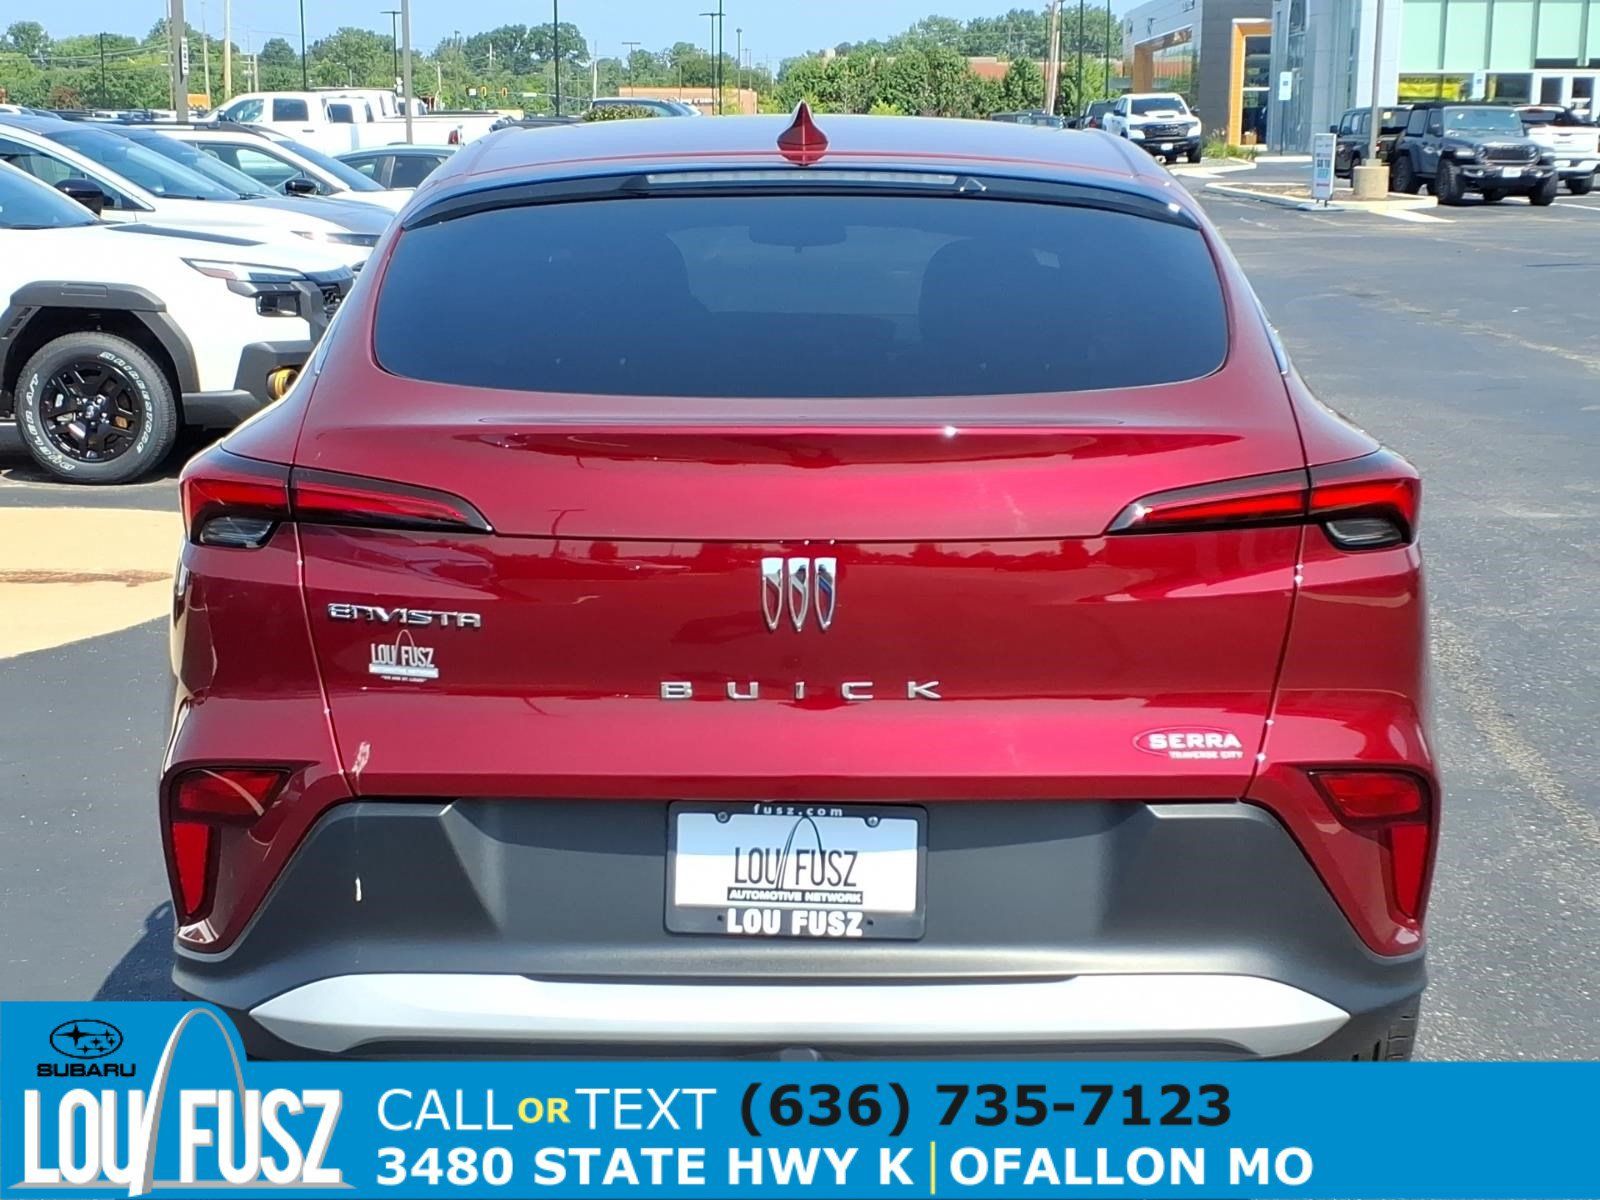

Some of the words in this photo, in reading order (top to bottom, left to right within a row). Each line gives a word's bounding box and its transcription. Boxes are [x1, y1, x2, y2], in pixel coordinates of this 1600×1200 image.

[327, 602, 481, 629] ENVISTA
[370, 643, 396, 665] LOU
[401, 645, 435, 667] FUSZ
[660, 681, 942, 701] BUICK
[1148, 733, 1242, 750] SERRA
[753, 804, 844, 818] fusz.com
[734, 847, 781, 884] LOU
[795, 848, 859, 887] FUSZ
[729, 889, 803, 902] AUTOMOTIVE
[805, 890, 863, 904] NETWORK
[727, 907, 781, 935] LOU
[791, 909, 864, 937] FUSZ
